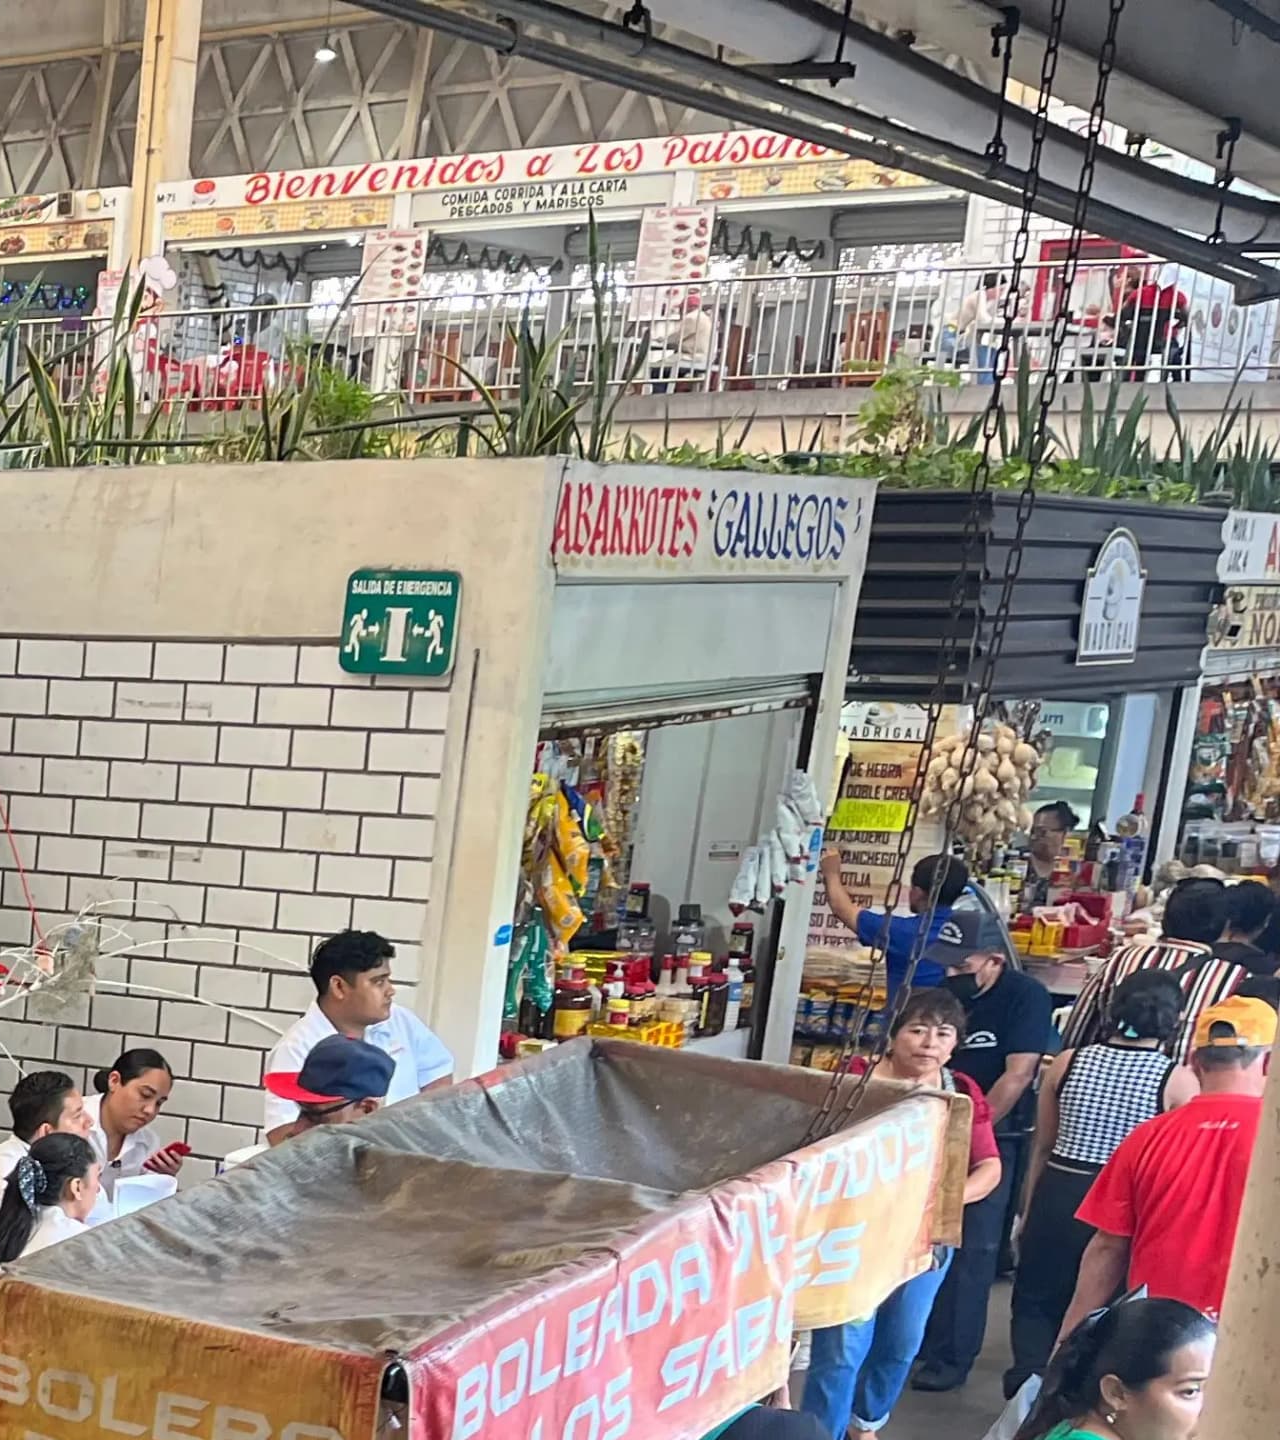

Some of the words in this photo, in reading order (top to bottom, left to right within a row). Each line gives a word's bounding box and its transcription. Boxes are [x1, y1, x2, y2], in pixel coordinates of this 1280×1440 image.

[245, 153, 505, 206] Bienvenidos
[526, 153, 551, 177] a
[441, 191, 488, 206] COMIDA
[495, 185, 544, 201] CORRIDA
[589, 179, 628, 194] CARTA
[450, 202, 513, 217] PESCADOS
[536, 195, 605, 210] MARISCOS
[551, 482, 702, 558] ABARROTES
[352, 579, 382, 594] SALIDA
[383, 580, 396, 595] DE
[396, 580, 452, 596] EMERGENCIA
[1084, 621, 1134, 651] MADRIGAL
[865, 763, 903, 779] HEBRA
[840, 871, 871, 888] OTIJA
